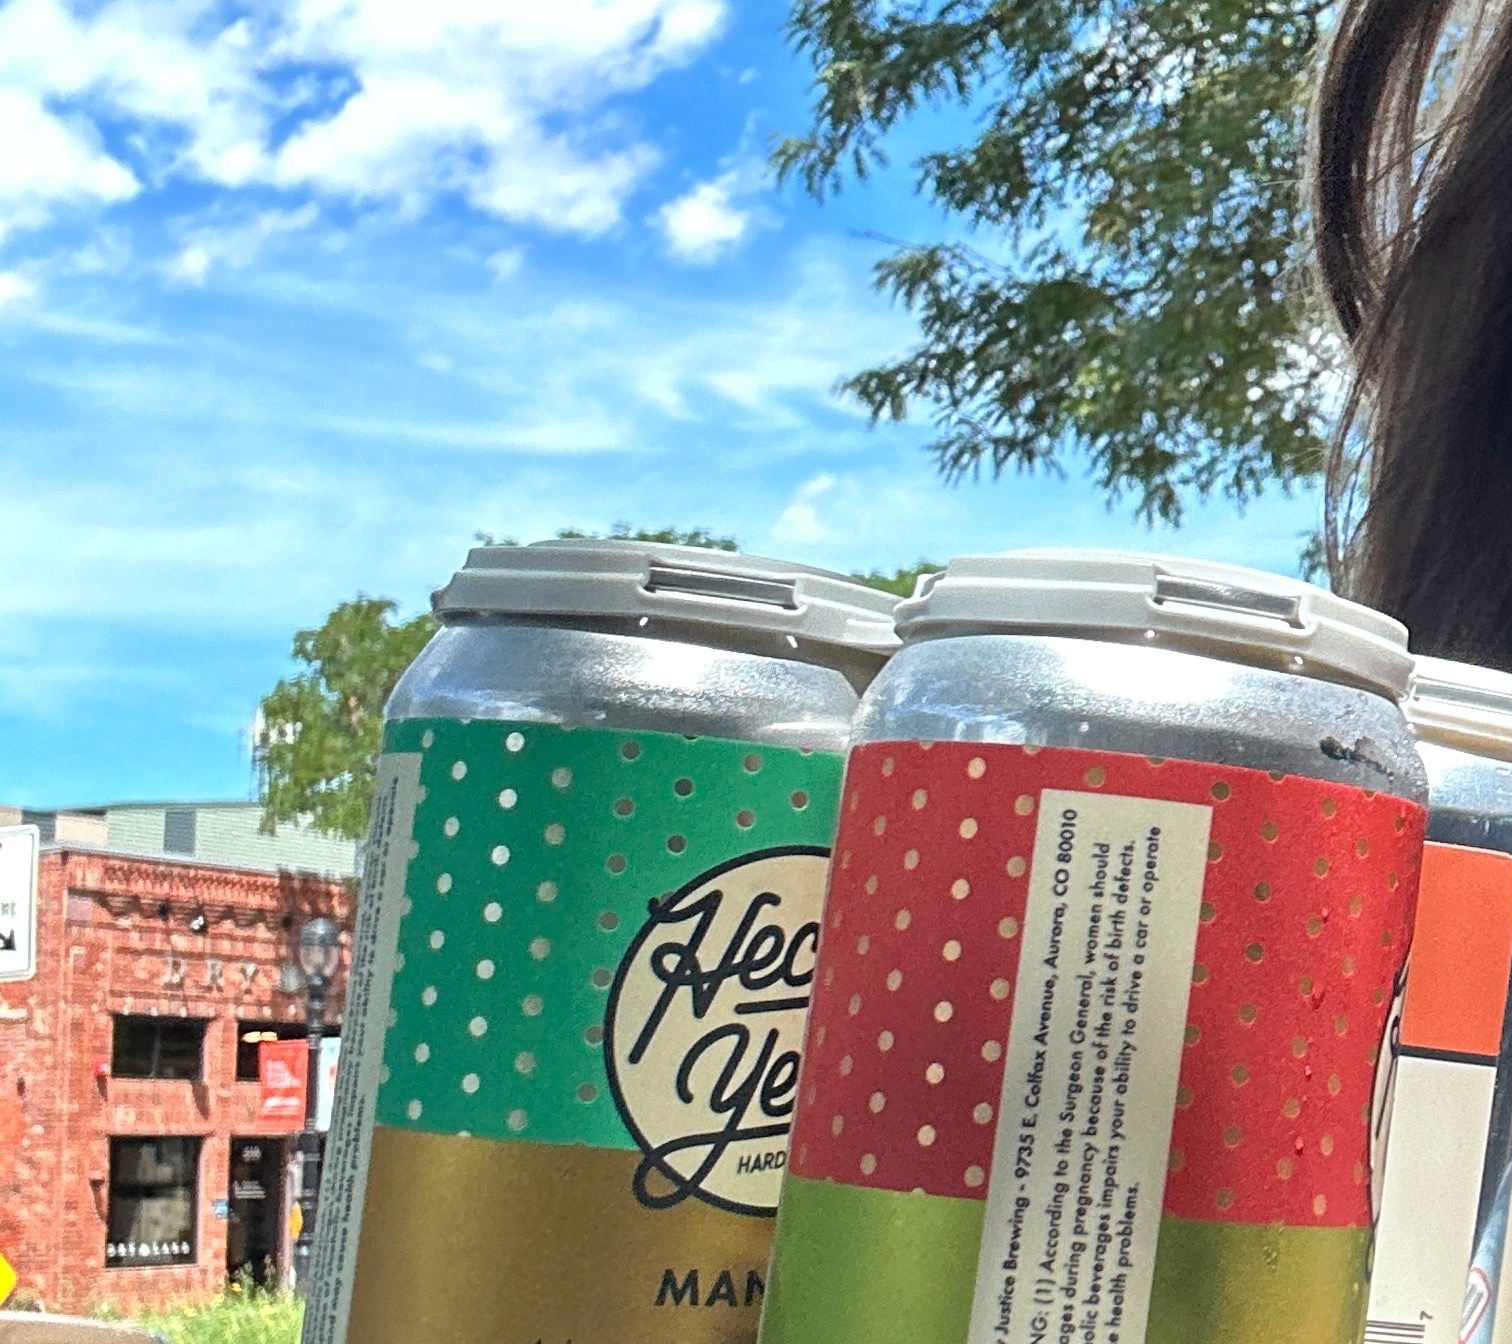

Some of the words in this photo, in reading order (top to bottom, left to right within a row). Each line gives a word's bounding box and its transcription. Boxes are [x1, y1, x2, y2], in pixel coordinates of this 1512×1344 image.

[1056, 808, 1078, 864] 80010
[1142, 826, 1162, 893] operate
[1052, 868, 1070, 897] CO
[1088, 842, 1110, 898] should
[1110, 840, 1135, 905] defects.
[1104, 910, 1126, 950] birth
[1139, 896, 1152, 916] or
[1042, 902, 1068, 970] Aurora,
[1084, 904, 1102, 965] women
[1103, 952, 1120, 972] of
[1132, 954, 1145, 966] a
[1135, 920, 1149, 949] car
[1033, 974, 1059, 1047] Avenue,
[1068, 971, 1097, 1045] General,
[1099, 976, 1118, 1007] risk
[1123, 970, 1143, 1014] drive
[1091, 1041, 1109, 1061] of
[1094, 1011, 1113, 1038] the
[1120, 1018, 1137, 1036] to
[1024, 1050, 1047, 1109] Colfax
[1059, 1050, 1083, 1123] Surgeon
[1113, 1039, 1138, 1096] ability
[1021, 1113, 1038, 1128] E.
[1082, 1065, 1106, 1137] because
[1110, 1098, 1125, 1140] your
[1014, 1133, 1035, 1179] 9735
[1053, 1159, 1069, 1177] to
[1054, 1128, 1073, 1154] the
[1072, 1141, 1100, 1236] pregnancy
[1101, 1145, 1121, 1209] impairs
[1002, 1196, 1031, 1270] Brewing
[1039, 1182, 1071, 1274] According
[1105, 1273, 1127, 1327] health
[1118, 1183, 1139, 1268] problems.
[1060, 1241, 1088, 1299] during
[1081, 1213, 1112, 1306] beverages
[993, 1275, 1016, 1336] Justice
[1033, 1278, 1057, 1305] (1)
